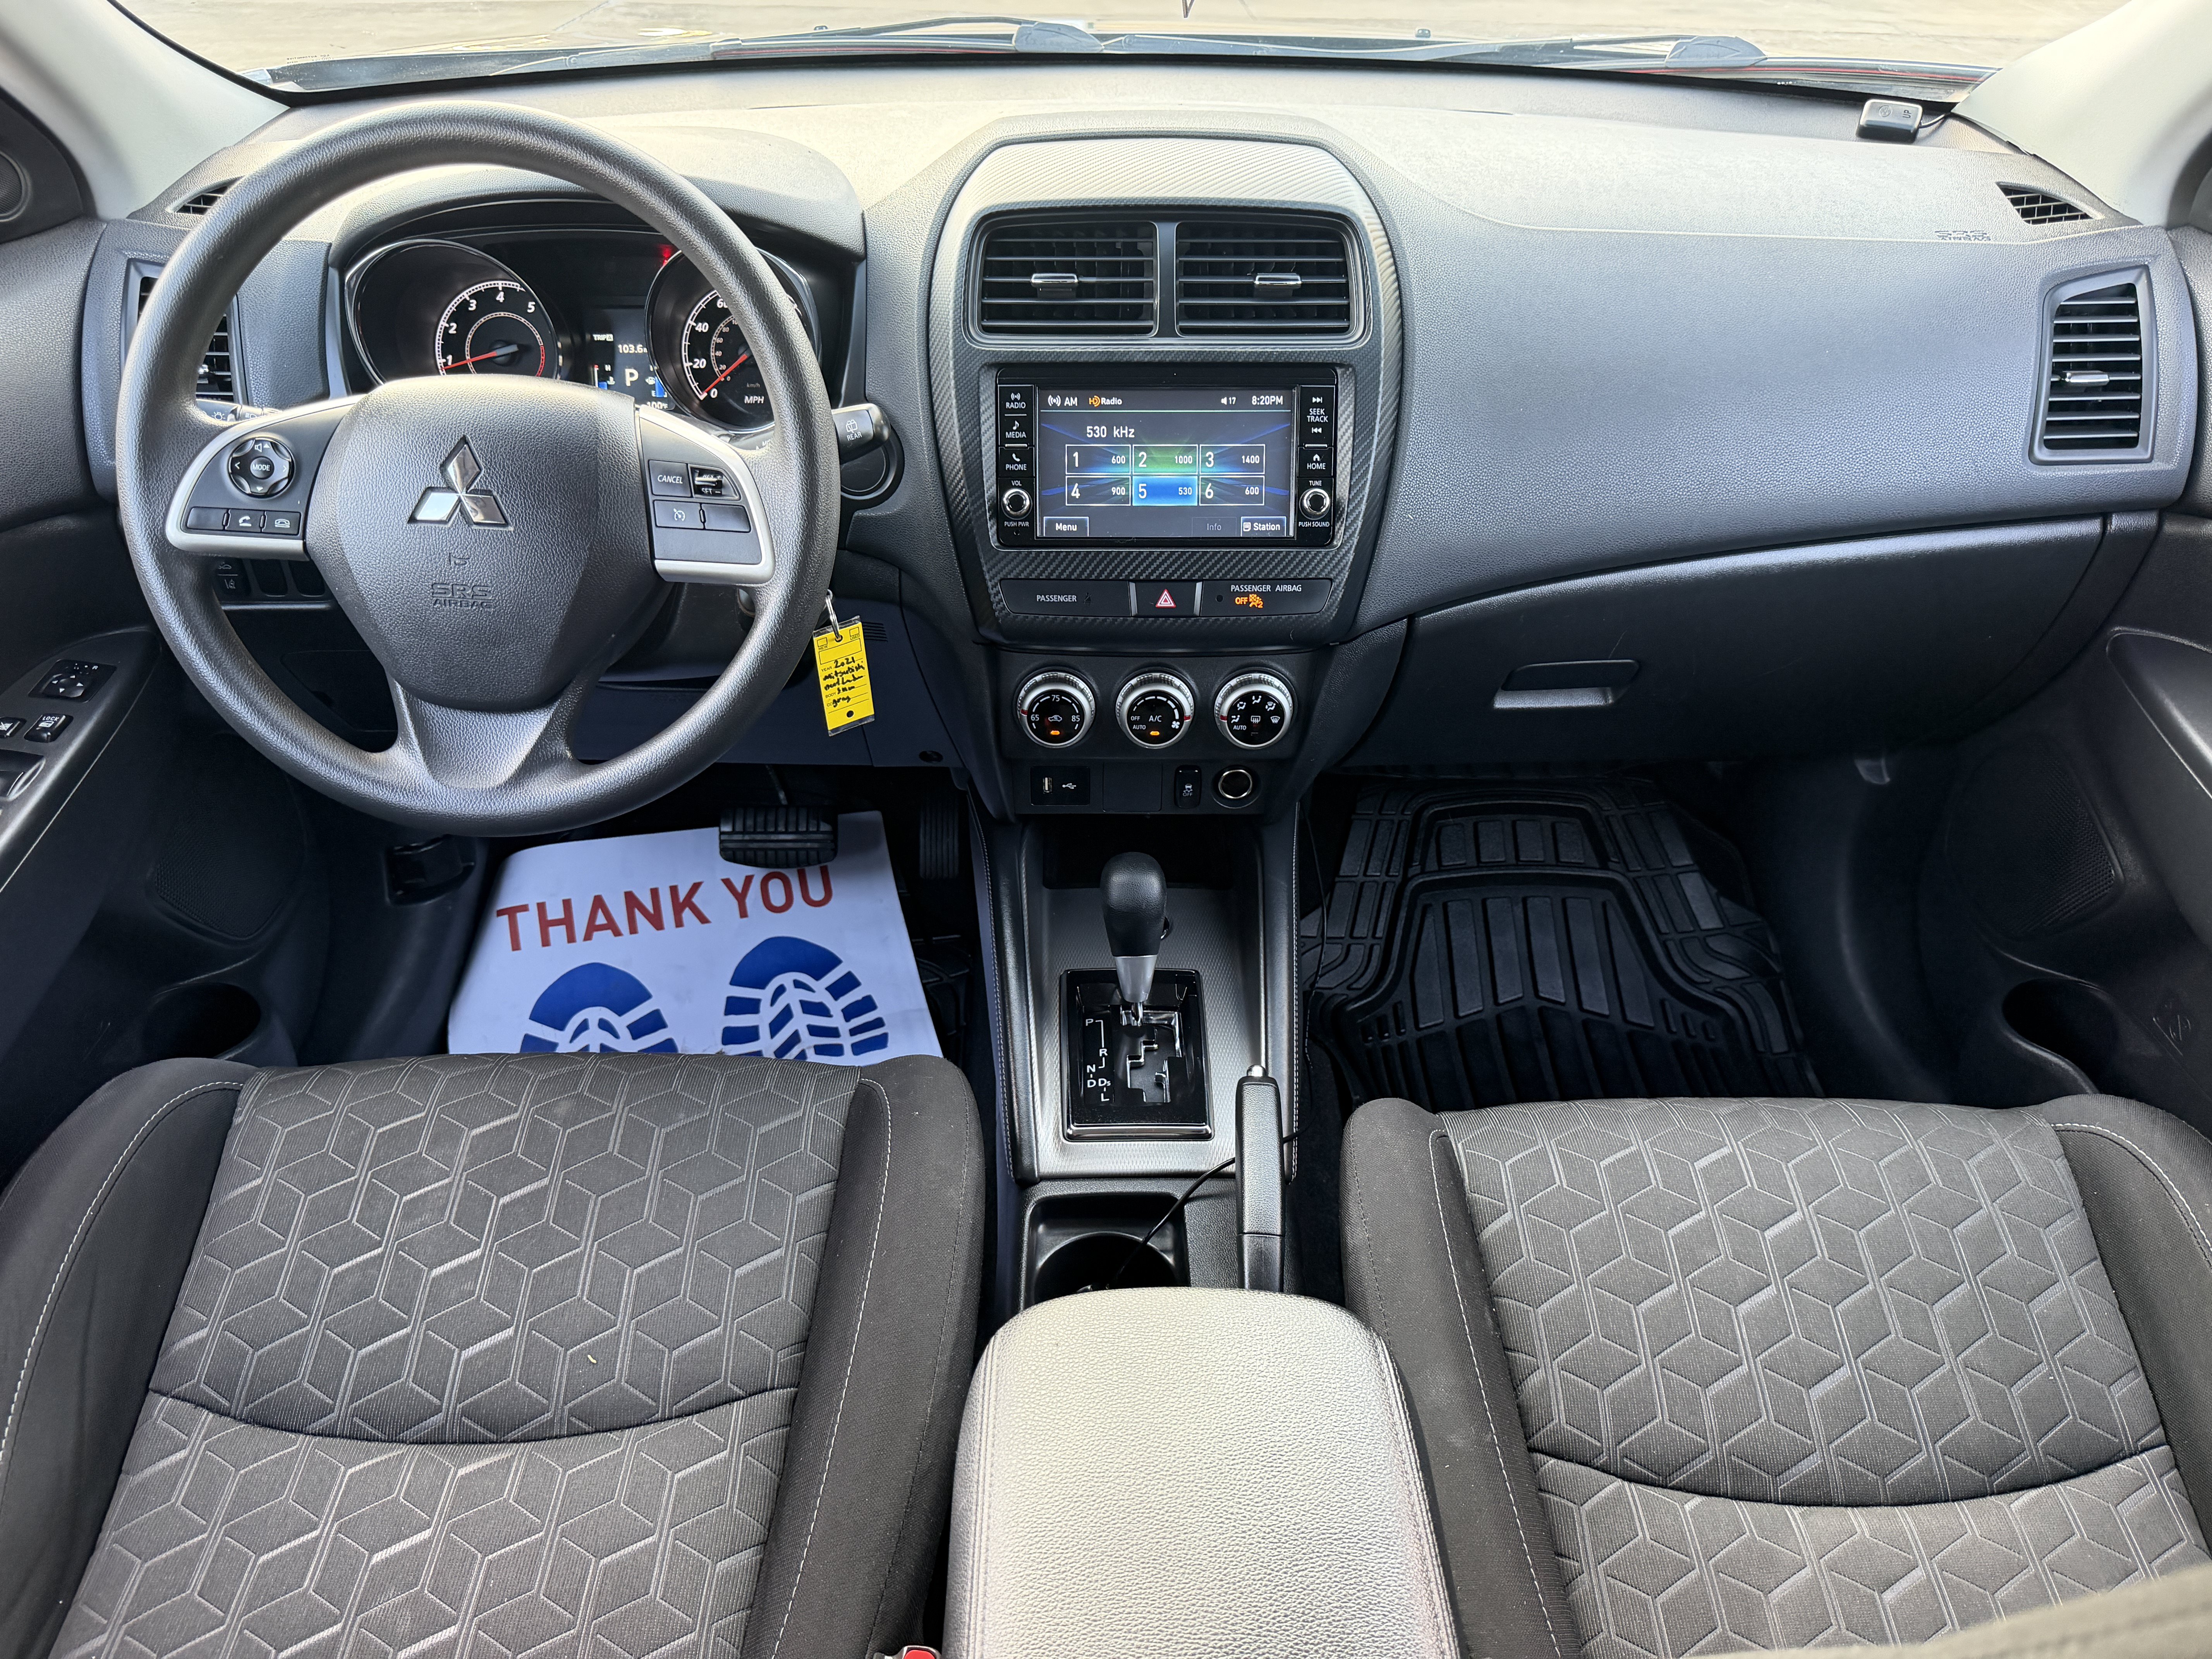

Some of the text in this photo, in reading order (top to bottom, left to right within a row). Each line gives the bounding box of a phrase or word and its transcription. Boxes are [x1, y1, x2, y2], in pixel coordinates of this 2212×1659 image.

[1903, 110, 1911, 118] UP
[496, 292, 505, 302] 4
[468, 299, 477, 311] 3
[527, 302, 536, 313] 5
[448, 323, 457, 334] 2
[695, 323, 709, 332] 40
[447, 355, 453, 365] 1
[692, 359, 706, 368] 20
[625, 368, 639, 386] P
[711, 388, 718, 398] 0
[1064, 397, 1078, 406] AM
[1252, 395, 1283, 405] 8:20PM
[847, 431, 862, 441] REAR
[1087, 426, 1135, 438] 530 kHz
[1073, 452, 1079, 467] 1
[1111, 455, 1126, 464] 600
[1139, 452, 1147, 467] 2
[1175, 455, 1193, 464] 1000
[1206, 452, 1214, 467] 3
[1242, 455, 1260, 464] 1400
[657, 475, 683, 484] CANCEL
[1071, 483, 1080, 499] 4
[1111, 487, 1126, 495] 900
[1139, 484, 1147, 499] 5
[1178, 487, 1192, 495] 530
[1205, 483, 1214, 498] 6
[1245, 487, 1259, 495] 600
[1056, 523, 1077, 531] Menu
[431, 582, 493, 600] SRS
[1275, 584, 1302, 592] AIRBAG
[1235, 596, 1248, 605] OFF
[834, 656, 855, 669] 2021
[496, 864, 834, 952] THANK YOU
[1101, 1093, 1109, 1101] L
